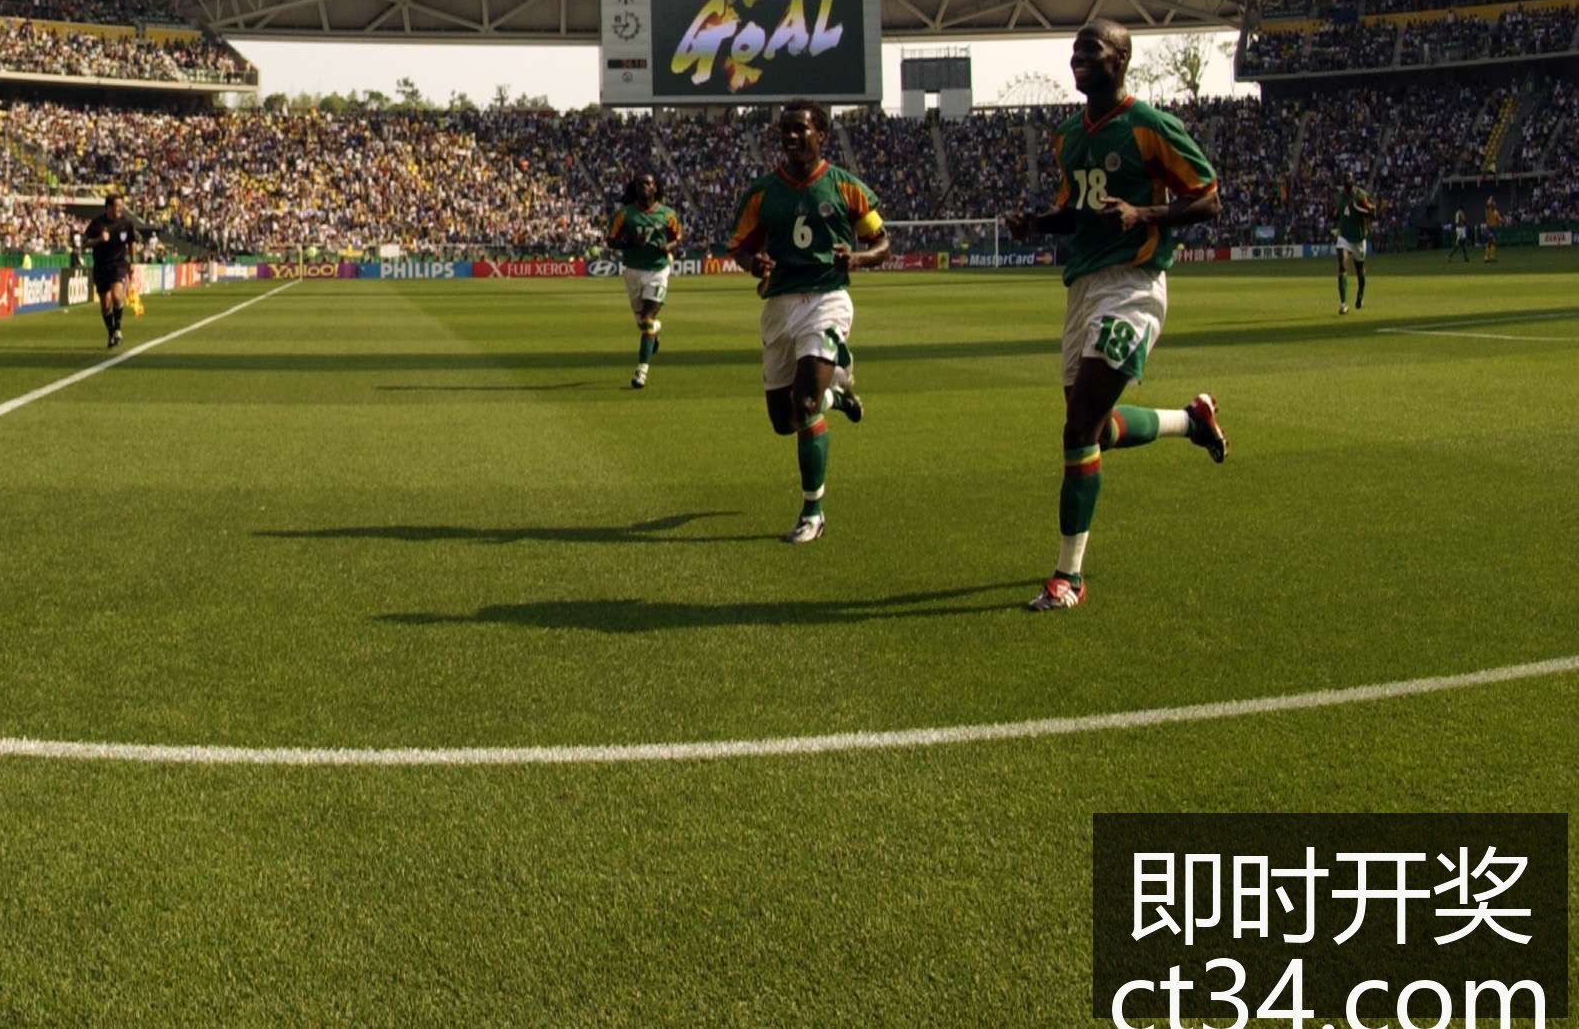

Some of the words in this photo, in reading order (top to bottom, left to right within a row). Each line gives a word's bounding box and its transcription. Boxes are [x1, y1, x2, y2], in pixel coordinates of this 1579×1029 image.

[1073, 168, 1107, 210] 18
[793, 215, 812, 249] 6
[969, 252, 1035, 266] MasterCard
[268, 263, 339, 278] YAHOO!
[380, 261, 454, 278] PHILIPS
[508, 262, 531, 276] FUJI
[534, 262, 576, 275] XEROX
